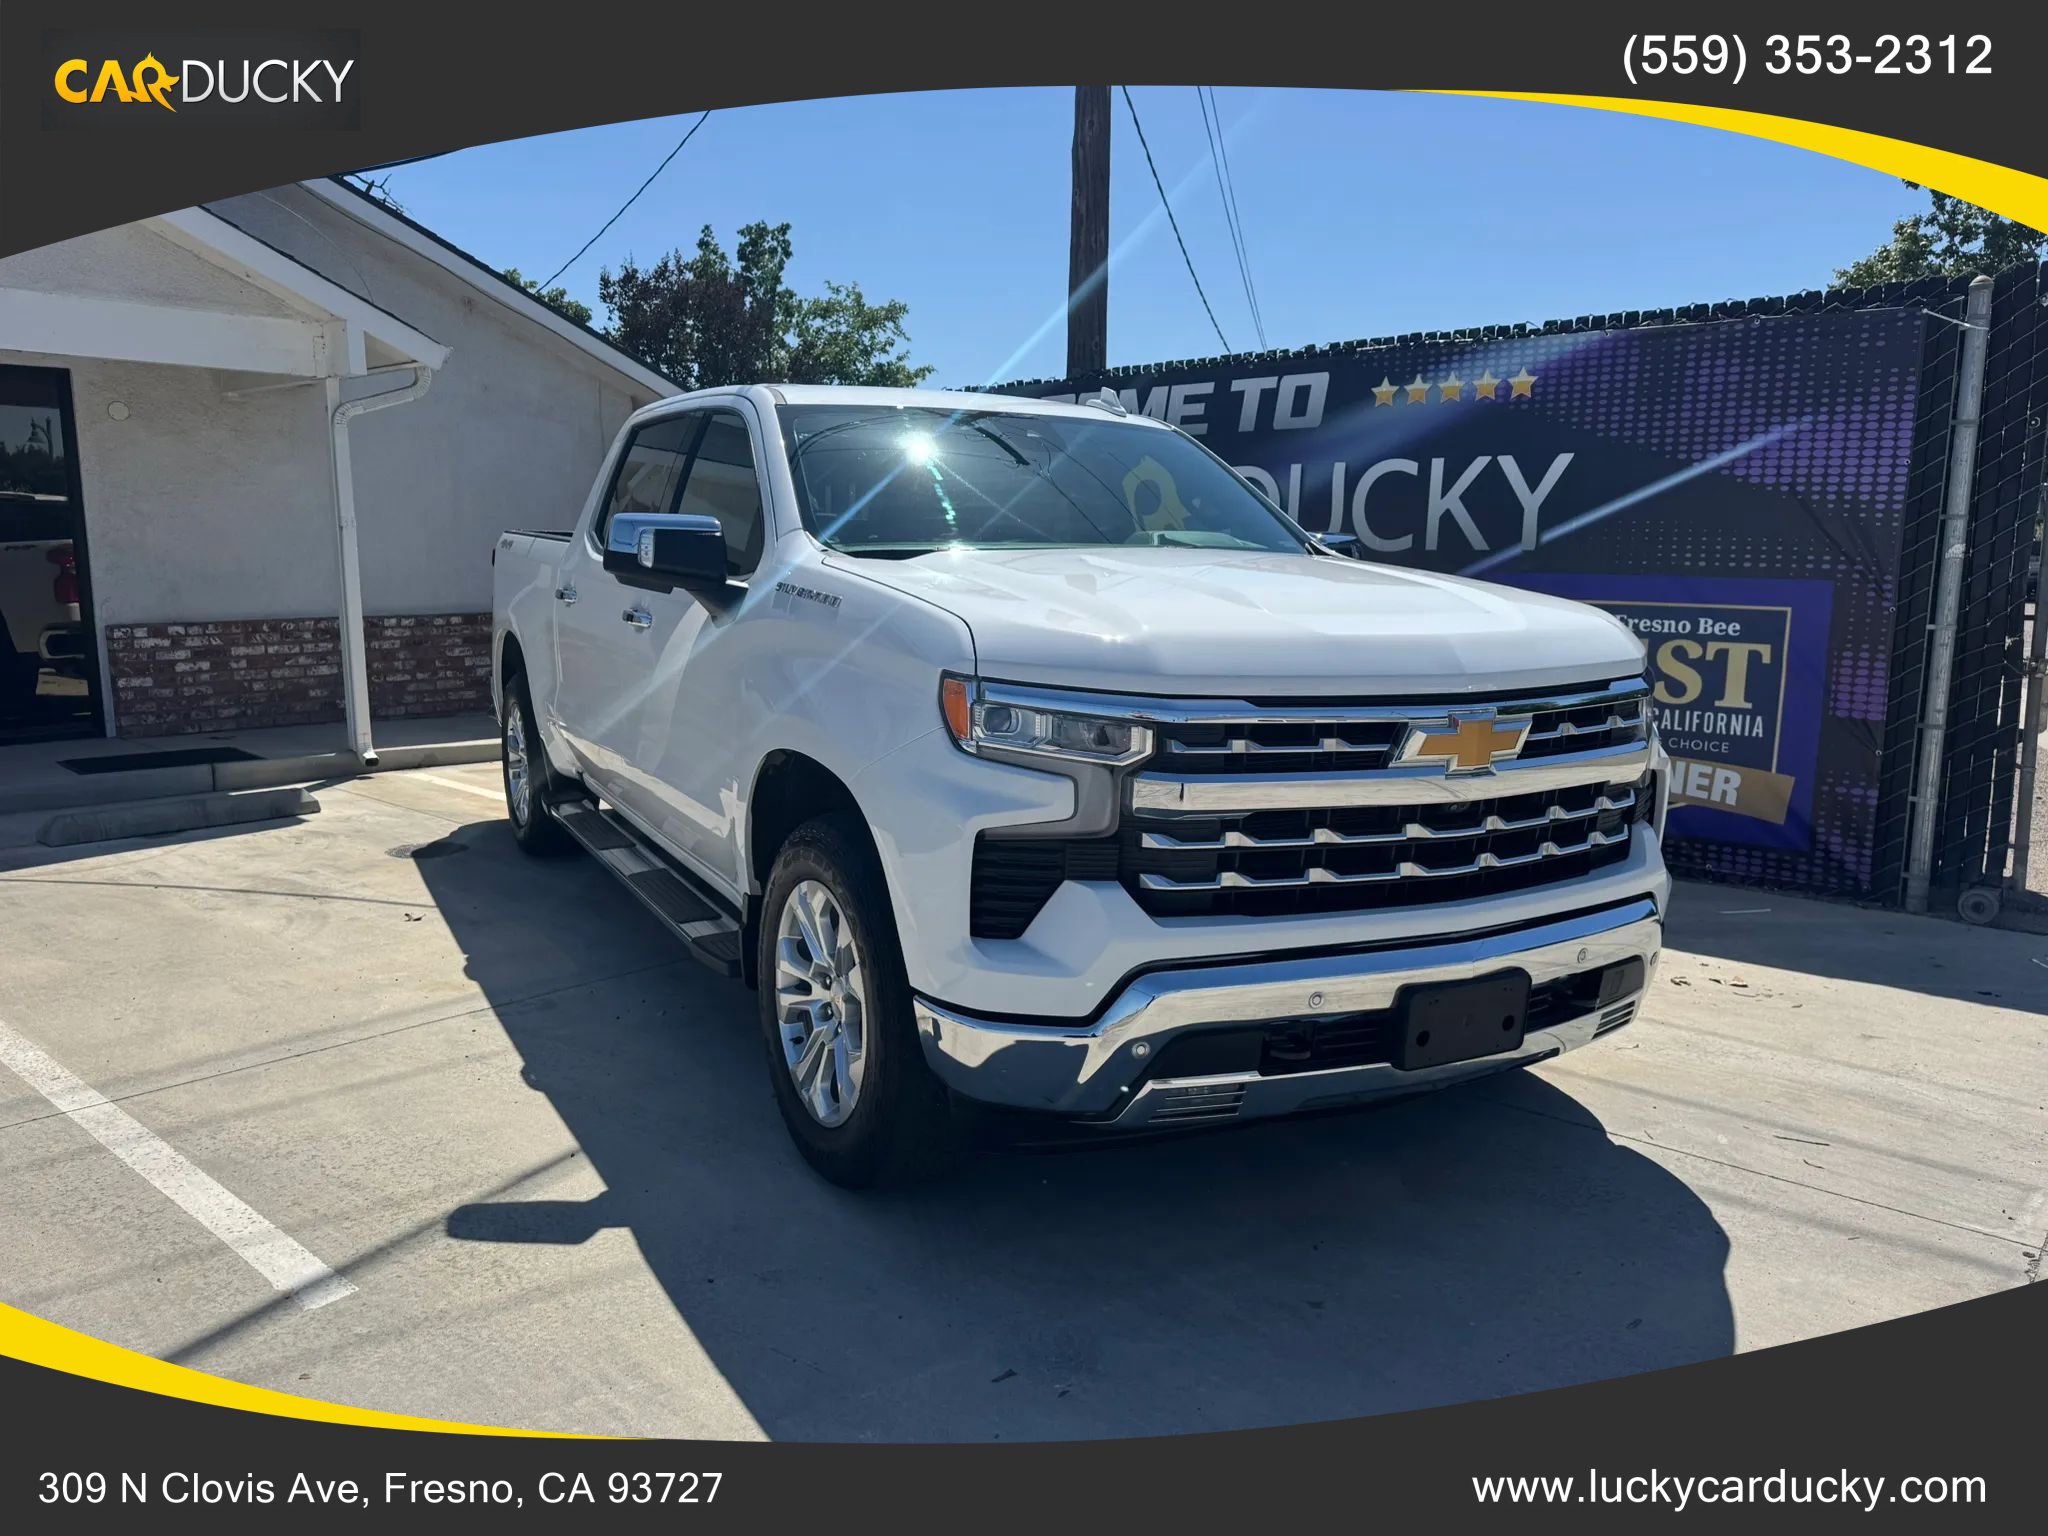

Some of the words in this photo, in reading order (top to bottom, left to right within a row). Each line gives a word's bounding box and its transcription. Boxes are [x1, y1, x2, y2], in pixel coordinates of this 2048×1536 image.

[1230, 371, 1330, 432] TO
[1696, 617, 1741, 636] Bee
[1640, 638, 1771, 709] ST
[1668, 737, 1730, 753] CHOICE
